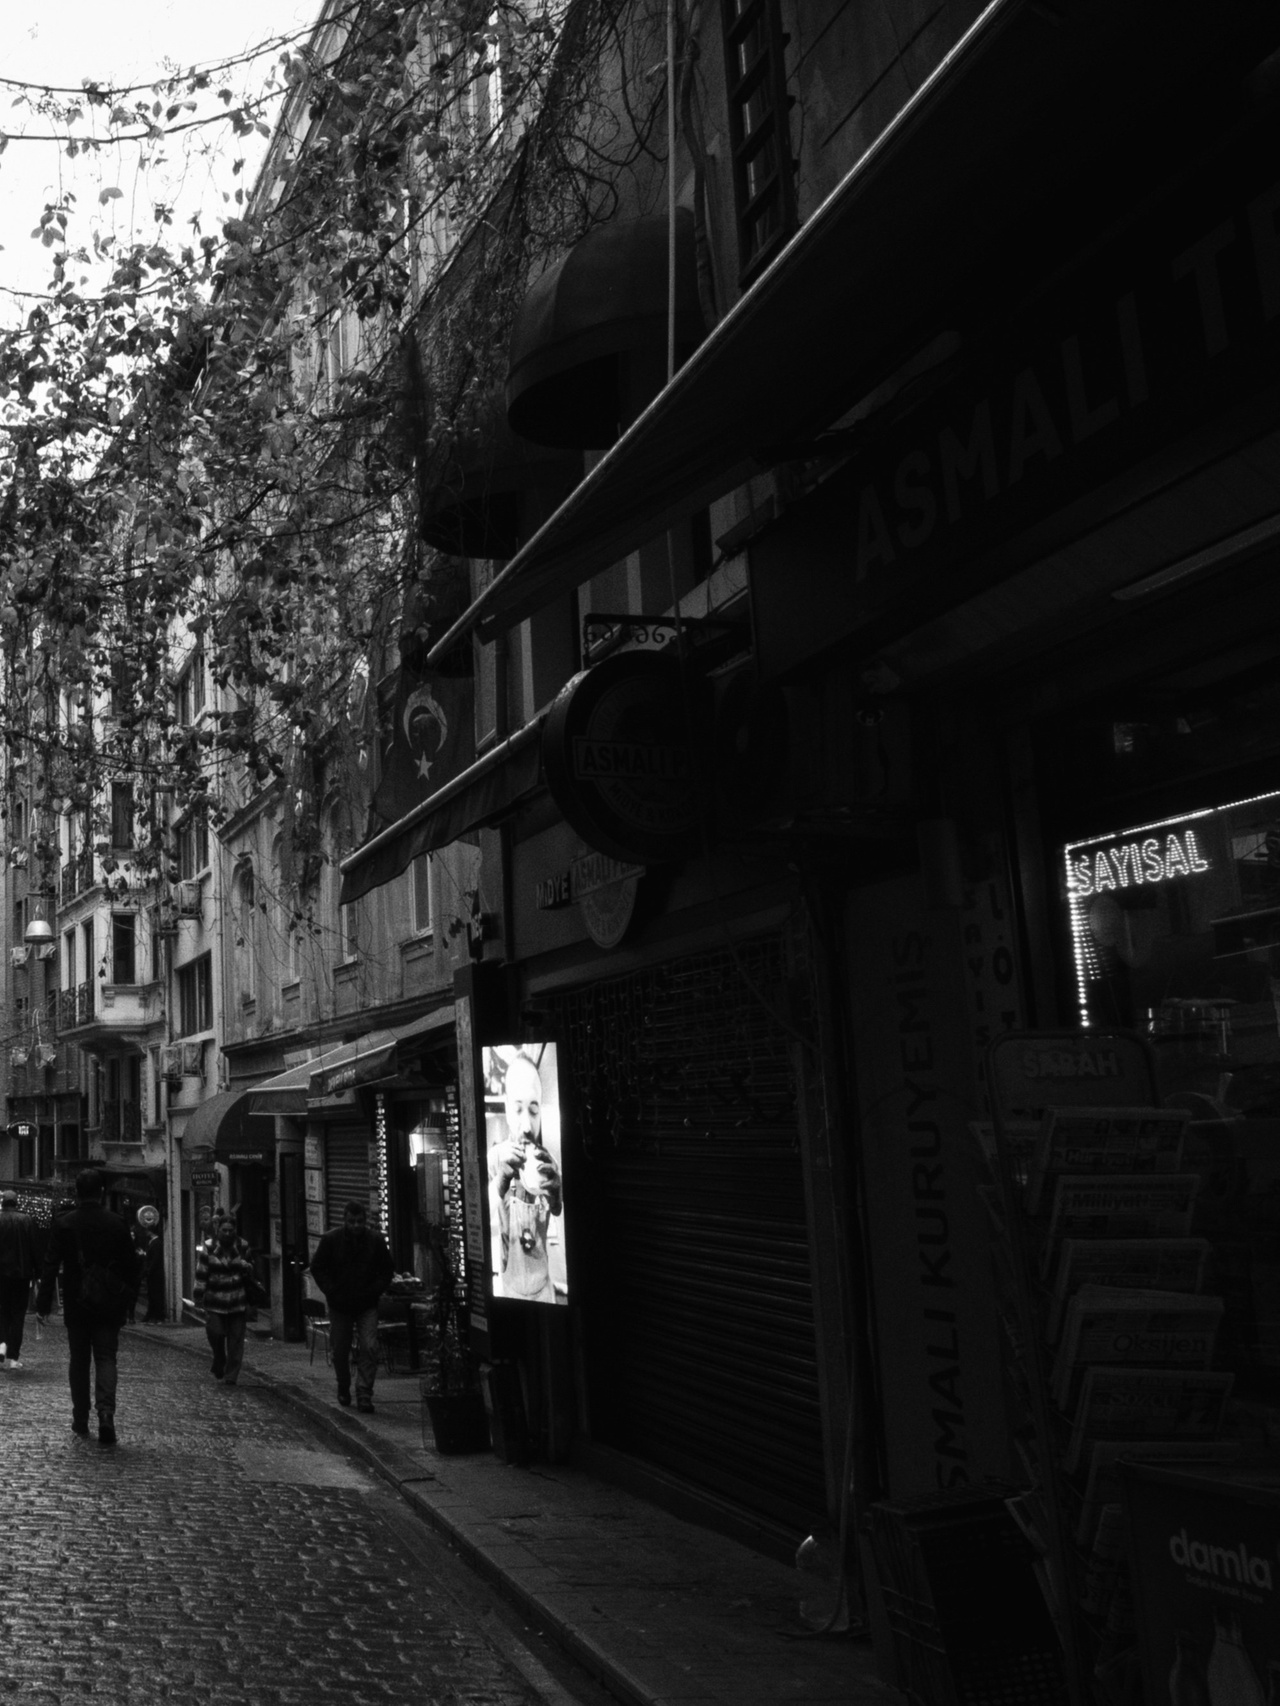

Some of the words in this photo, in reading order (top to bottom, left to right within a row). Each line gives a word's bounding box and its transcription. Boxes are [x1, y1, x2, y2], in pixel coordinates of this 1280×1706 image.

[856, 290, 1149, 583] ASMALI
[583, 745, 666, 775] ASMALI
[1073, 830, 1209, 897] SAYISAL
[1023, 1050, 1121, 1080] SABAH
[888, 929, 953, 1289] KURUYEMİŞ
[1113, 1333, 1207, 1355] Oksijen
[1169, 1527, 1273, 1592] damla
